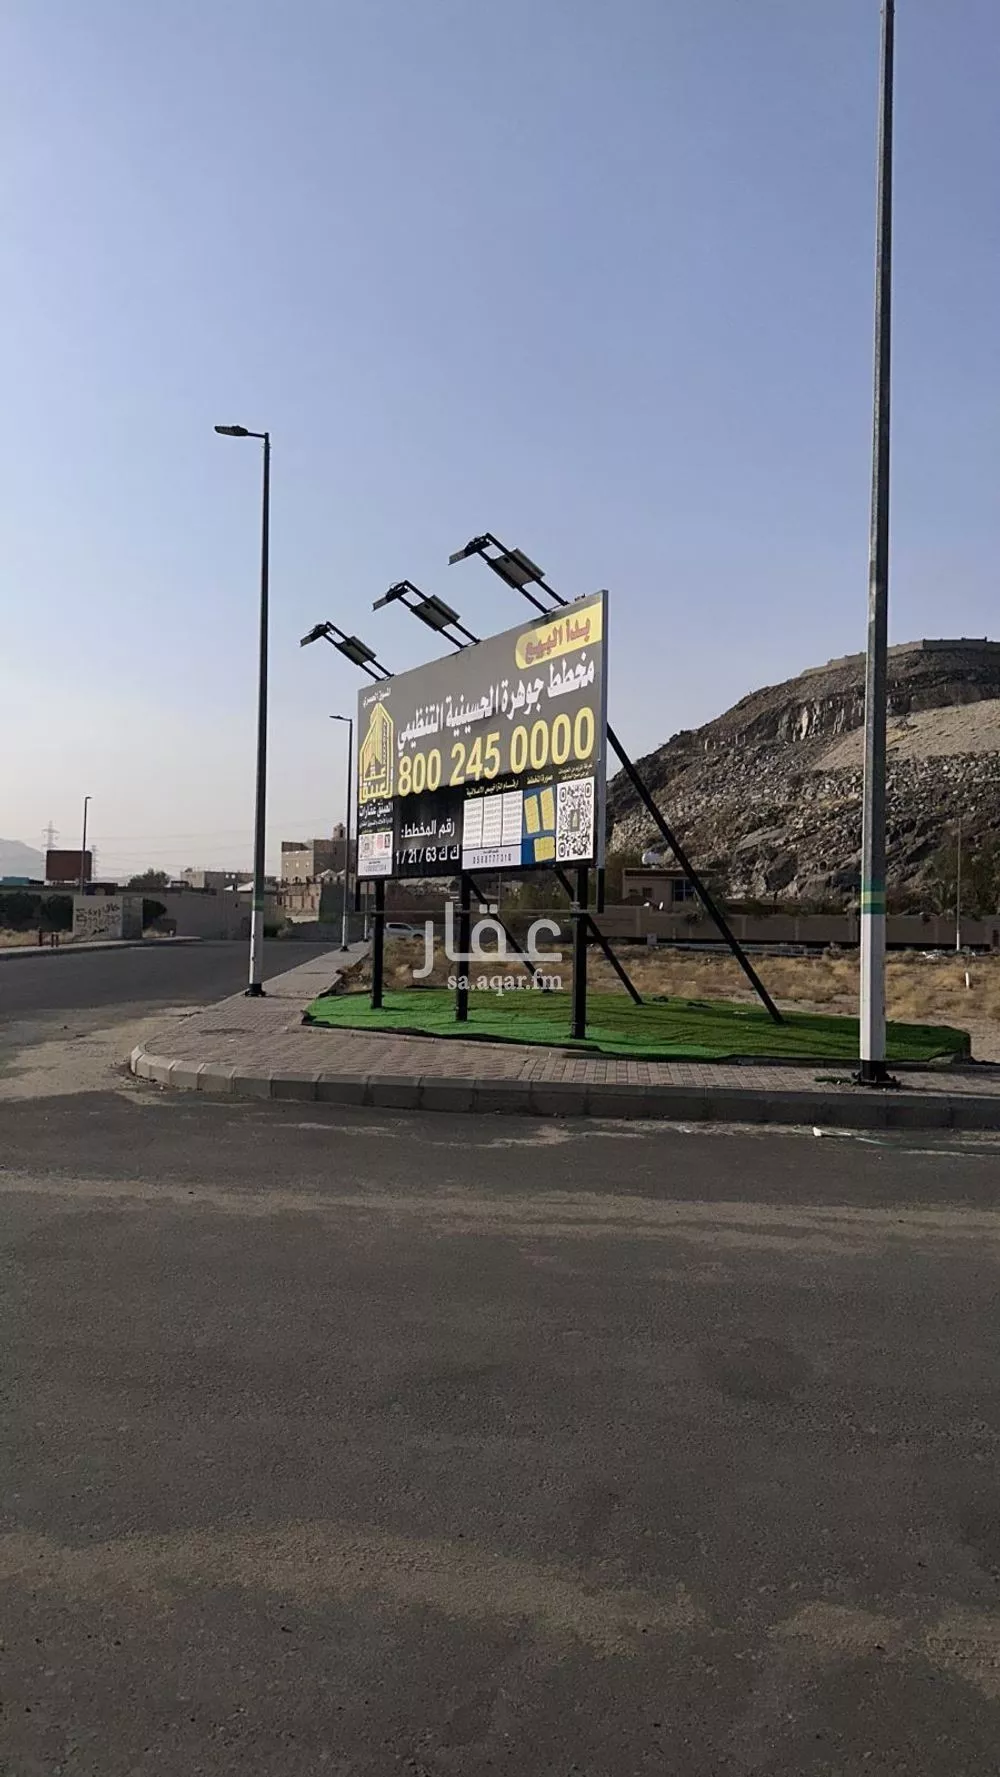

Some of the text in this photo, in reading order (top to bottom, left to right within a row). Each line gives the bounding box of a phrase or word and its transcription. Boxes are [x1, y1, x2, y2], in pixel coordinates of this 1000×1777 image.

[525, 624, 563, 665] البيع
[547, 651, 595, 698] مخطط
[501, 678, 544, 720] جوهرة
[446, 683, 499, 736] الحسينية
[398, 702, 444, 757] التنظيمي
[398, 749, 441, 797] 800
[450, 732, 500, 786] 245
[510, 706, 595, 774] 0000
[401, 820, 437, 838] المخطط:
[438, 818, 455, 838] رقم
[401, 849, 407, 864] /
[407, 848, 417, 864] 21
[418, 847, 424, 863] /
[425, 846, 437, 862] 63
[439, 845, 448, 860] ك
[450, 844, 459, 860] ك
